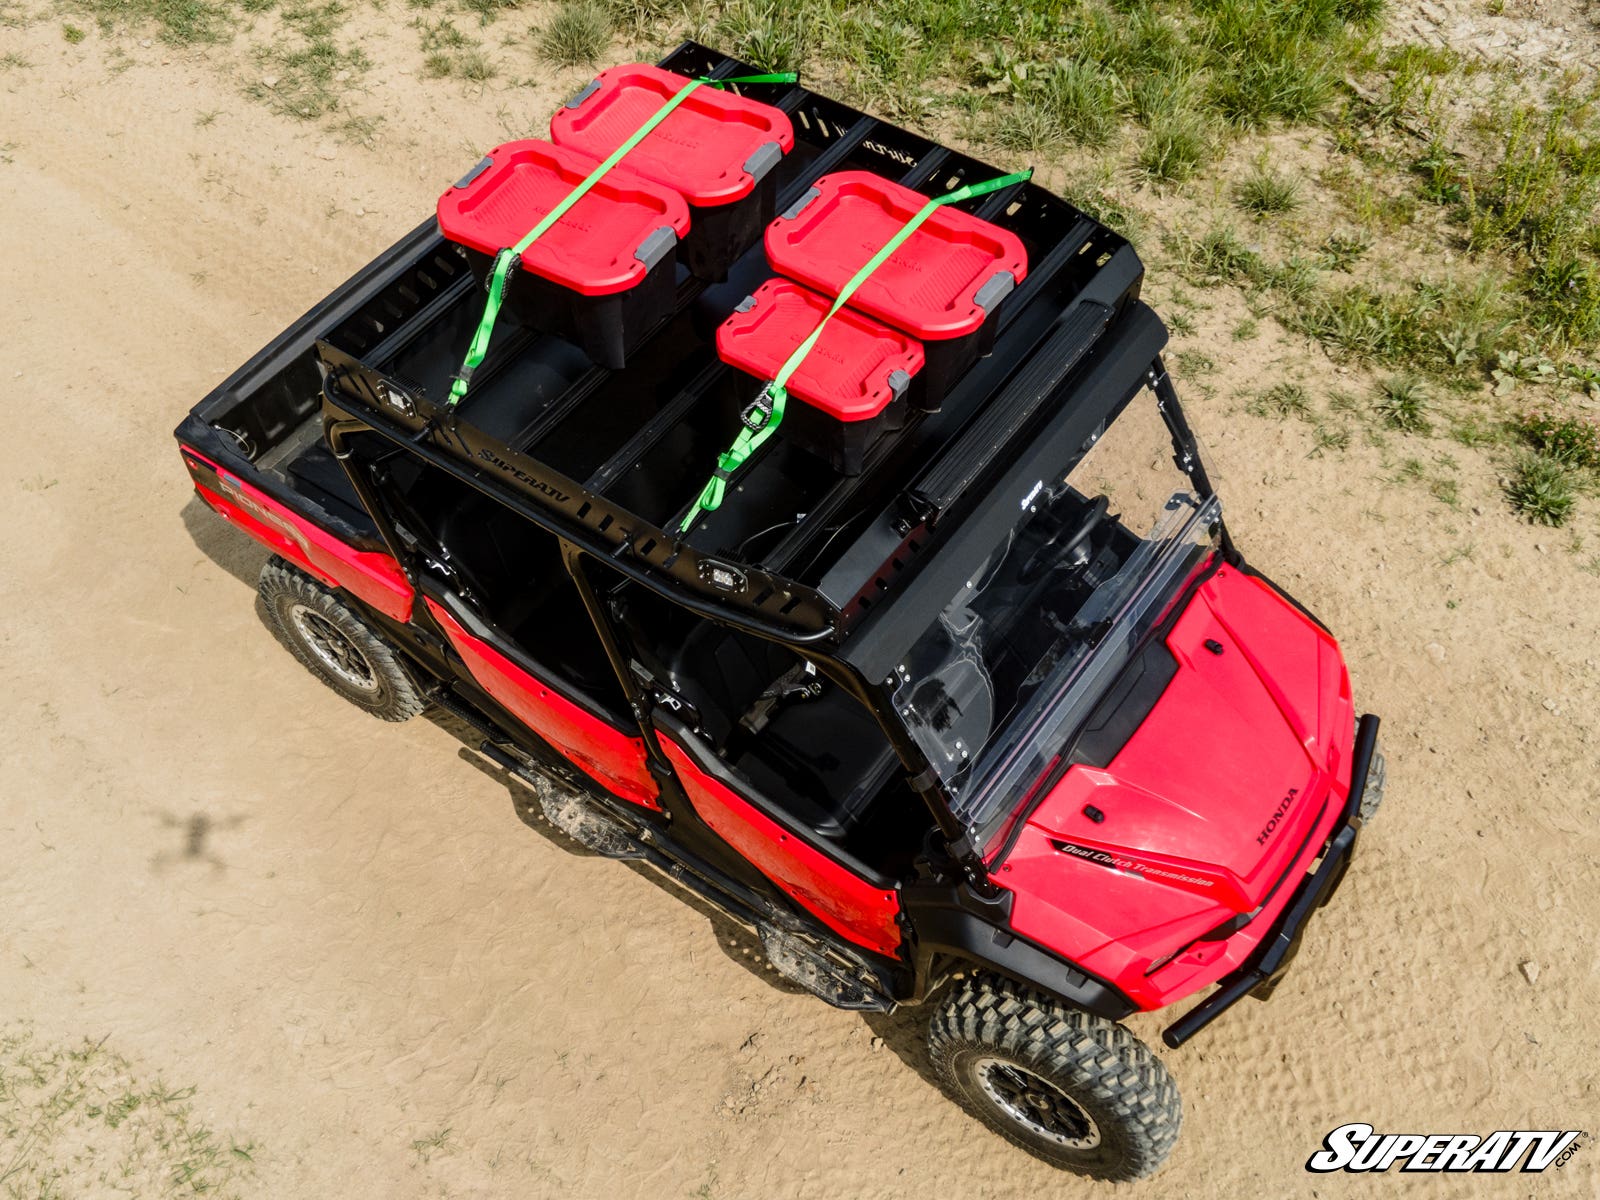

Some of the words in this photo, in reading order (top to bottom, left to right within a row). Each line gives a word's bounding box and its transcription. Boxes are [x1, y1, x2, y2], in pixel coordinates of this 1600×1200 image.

[478, 448, 571, 503] SUPERATV
[1256, 788, 1299, 846] HONDA
[1062, 844, 1091, 858] Dual
[1094, 853, 1133, 868] Clutch
[1134, 863, 1215, 887] Transmission
